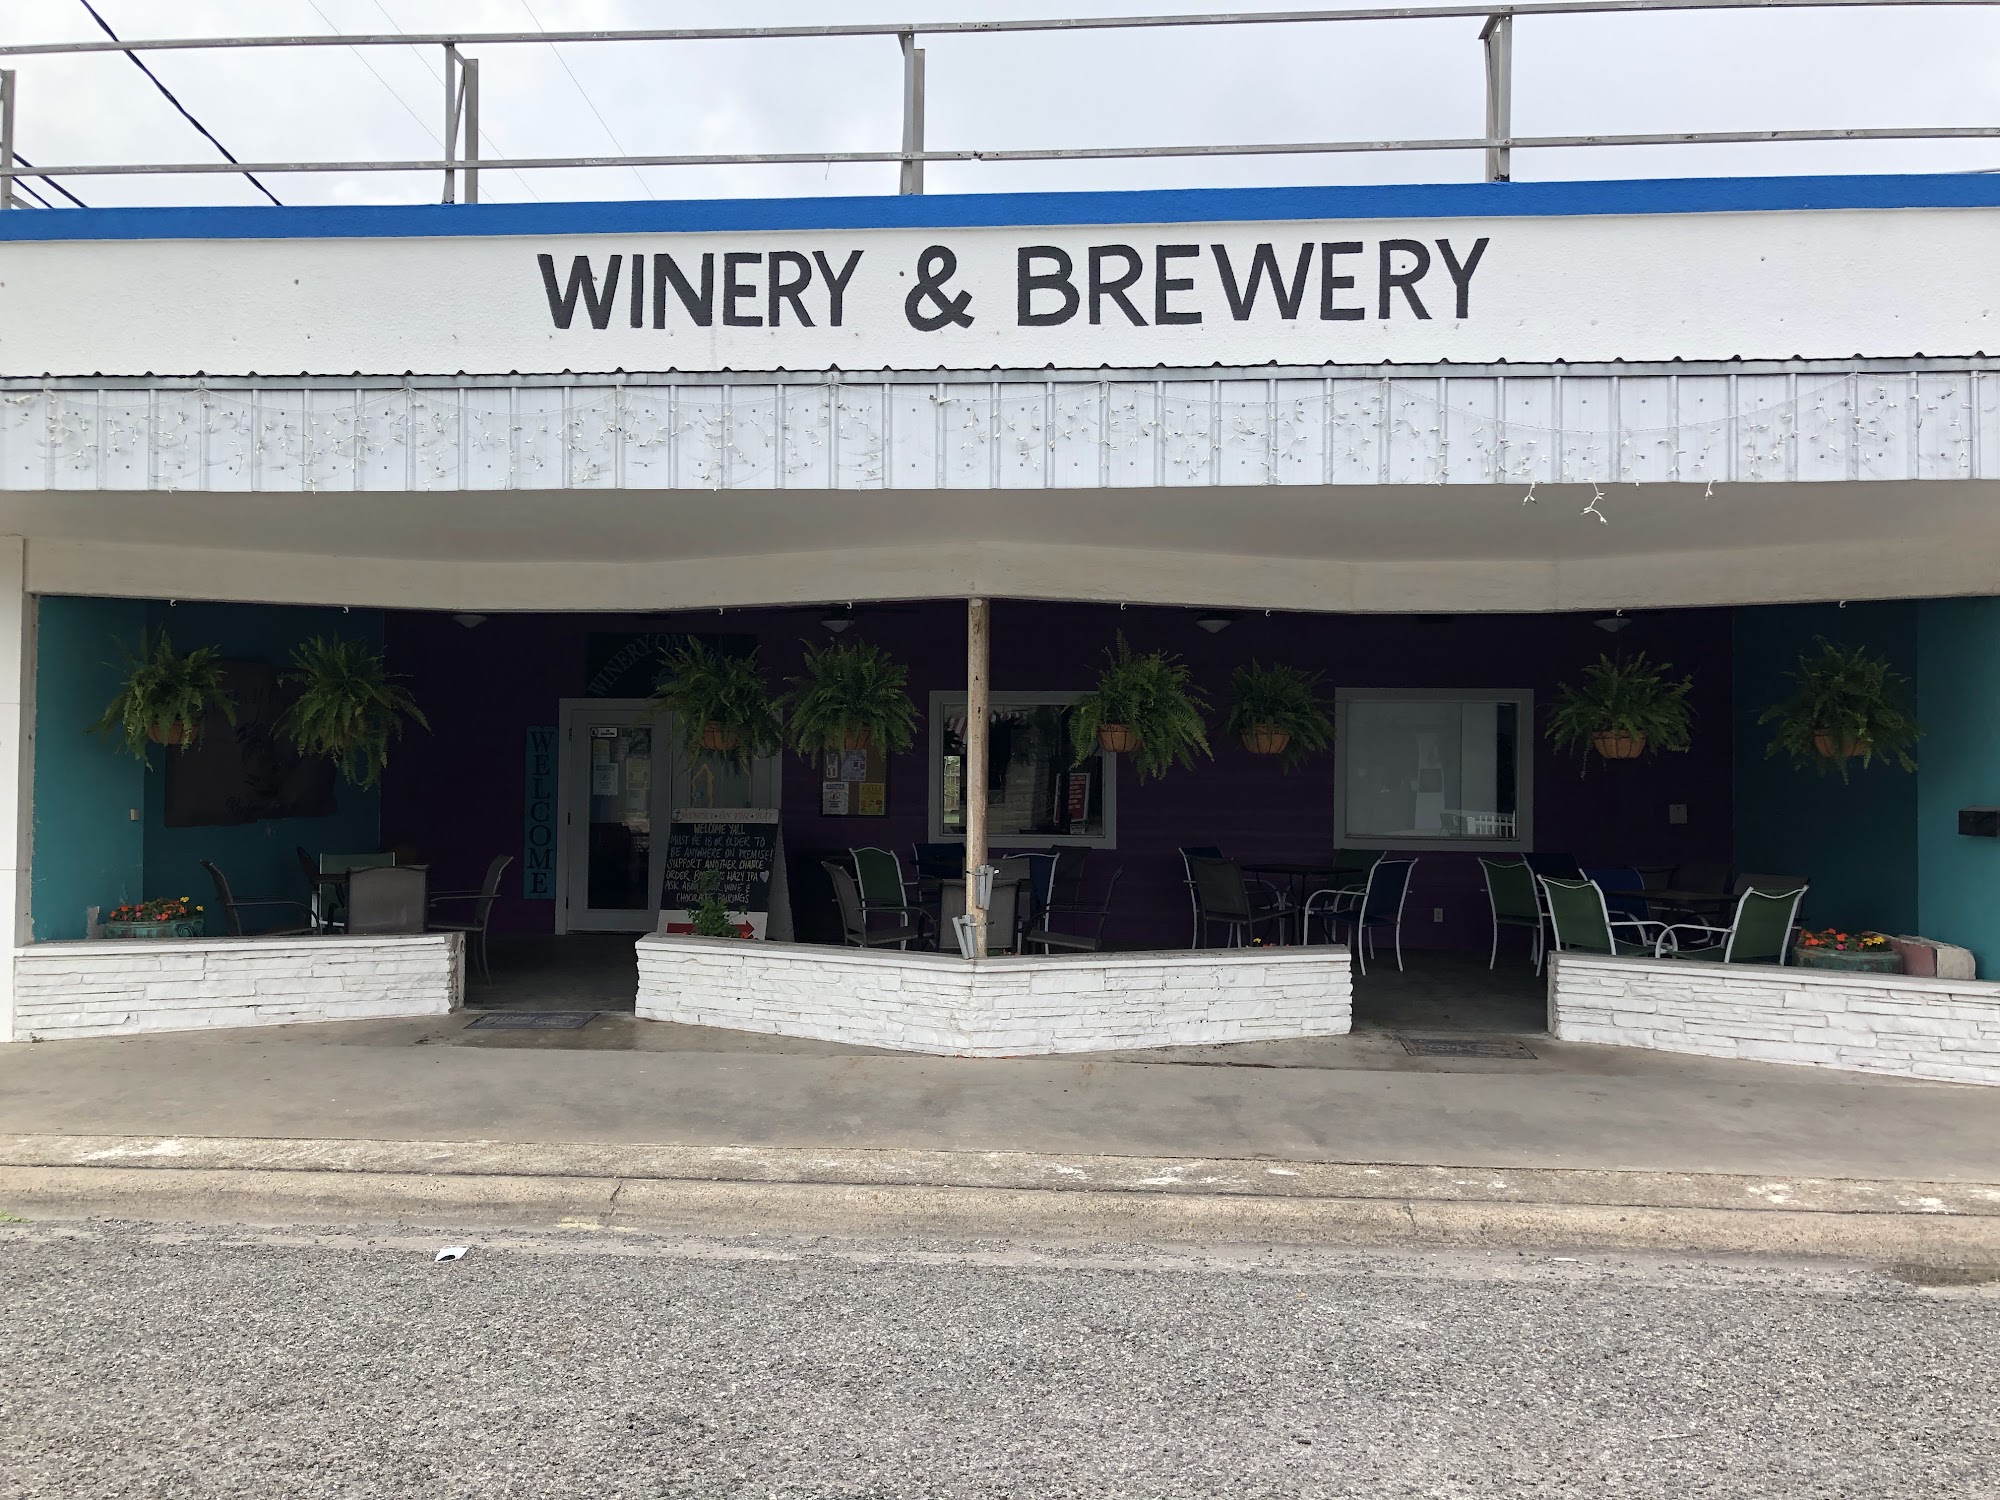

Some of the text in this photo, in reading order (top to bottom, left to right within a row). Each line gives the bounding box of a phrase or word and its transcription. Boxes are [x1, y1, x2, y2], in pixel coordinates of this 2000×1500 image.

[537, 237, 1490, 332] WINERY & BREWERY
[588, 634, 653, 698] WINERY
[527, 731, 555, 894] WELCOME
[682, 811, 714, 820] WINERY
[718, 811, 733, 820] ON
[693, 823, 727, 835] WELCOME
[671, 835, 766, 847] MUST BE 18 OR OLDER TO
[671, 846, 774, 861] BE ANYWHERE ON PREMISE!
[667, 858, 764, 869] SUPPORT ANOTHER CHANCE
[666, 870, 691, 881] ORDER
[727, 871, 745, 881] HAZY
[747, 871, 759, 881] IPA
[665, 880, 679, 890] ASK
[724, 882, 744, 892] WINE
